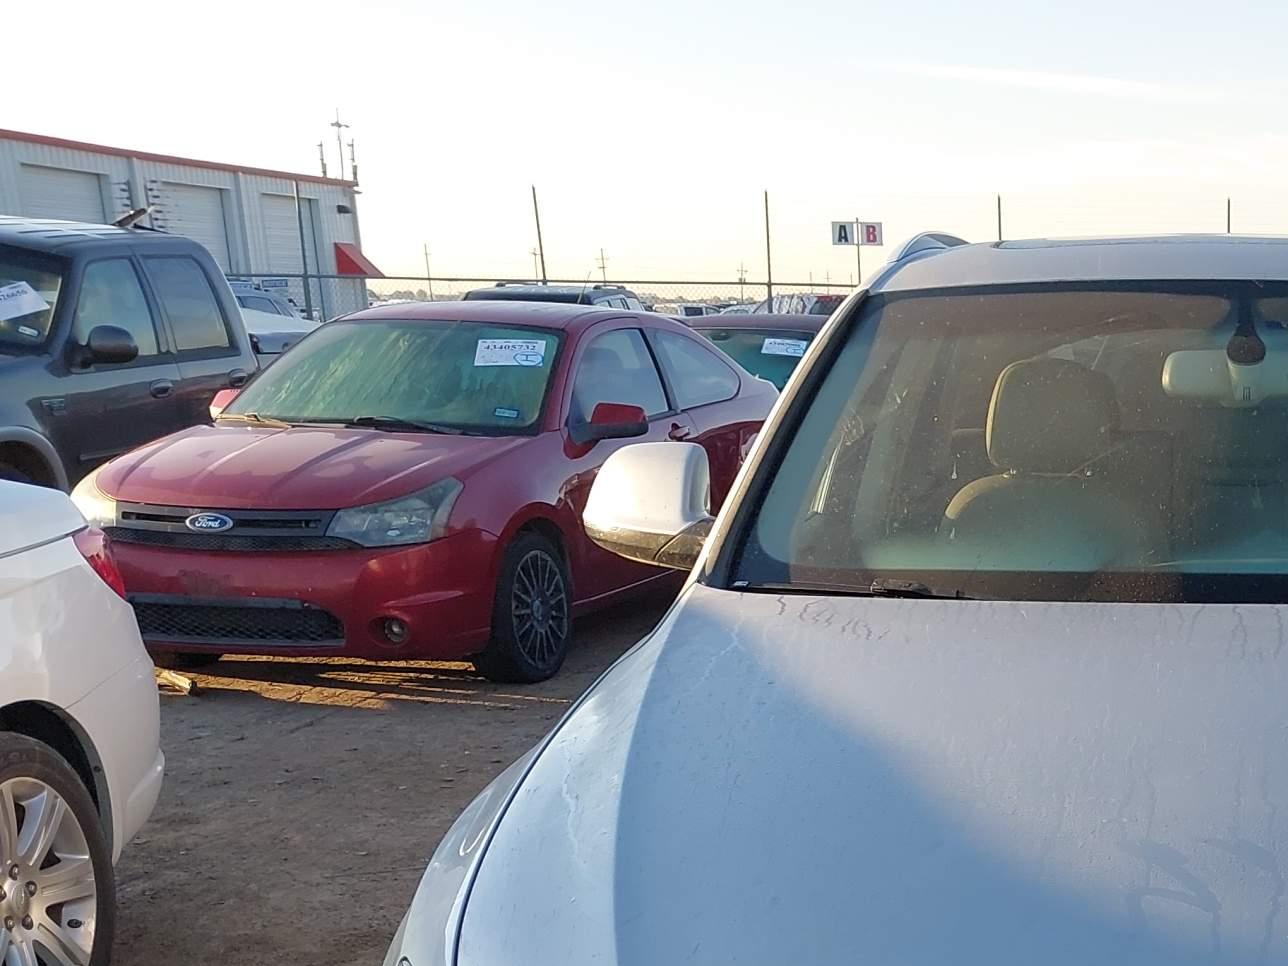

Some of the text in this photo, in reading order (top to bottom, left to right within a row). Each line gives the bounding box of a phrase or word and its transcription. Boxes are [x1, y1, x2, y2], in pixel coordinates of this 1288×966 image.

[838, 225, 849, 243] A
[866, 225, 877, 243] B
[195, 516, 221, 529] Ford
